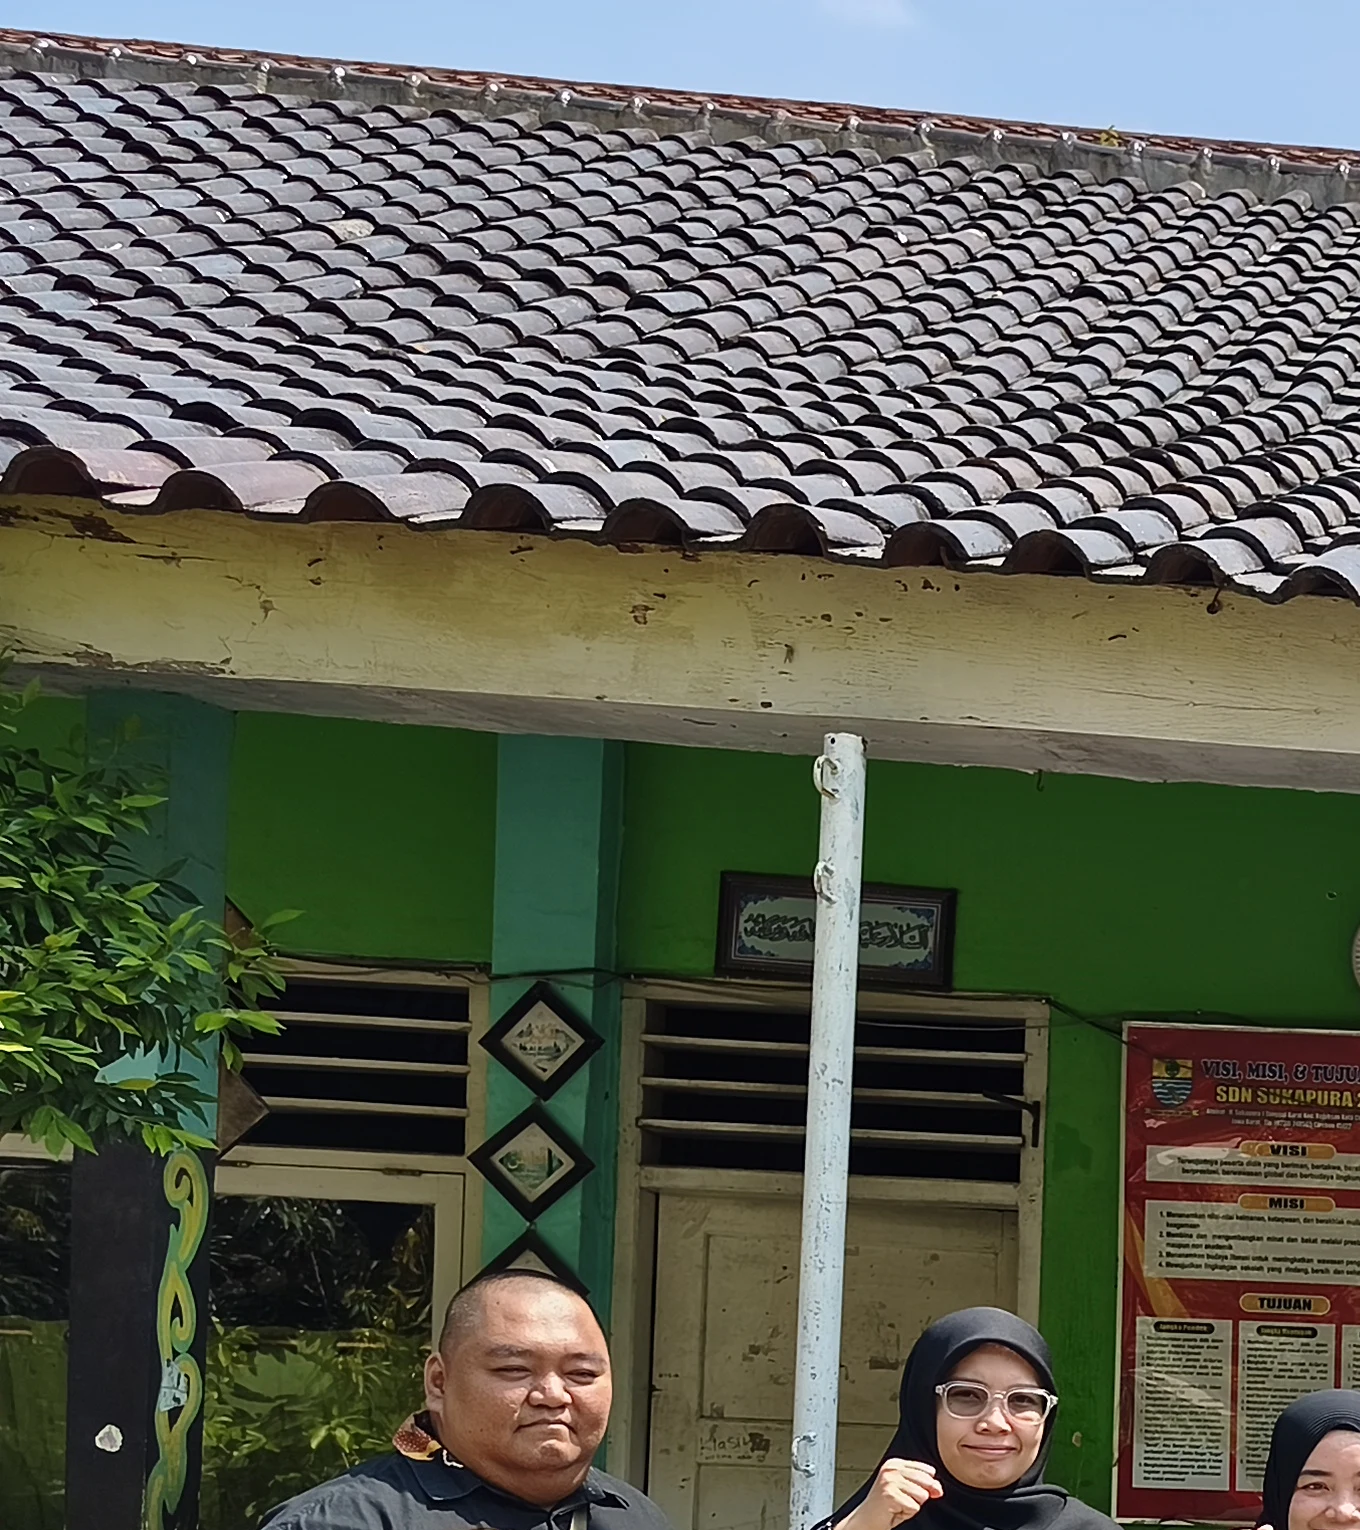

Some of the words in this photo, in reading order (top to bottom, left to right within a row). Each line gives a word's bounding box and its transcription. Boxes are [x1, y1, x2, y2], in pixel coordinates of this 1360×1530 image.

[1201, 1059, 1243, 1082] VISI,
[1246, 1061, 1289, 1084] MISI,
[1293, 1063, 1307, 1082] &
[1216, 1086, 1252, 1103] SDN
[1257, 1087, 1353, 1107] SUKAPURA
[1269, 1144, 1307, 1157] VISI
[1268, 1197, 1305, 1209] MISI
[1258, 1297, 1312, 1311] TUJUAN
